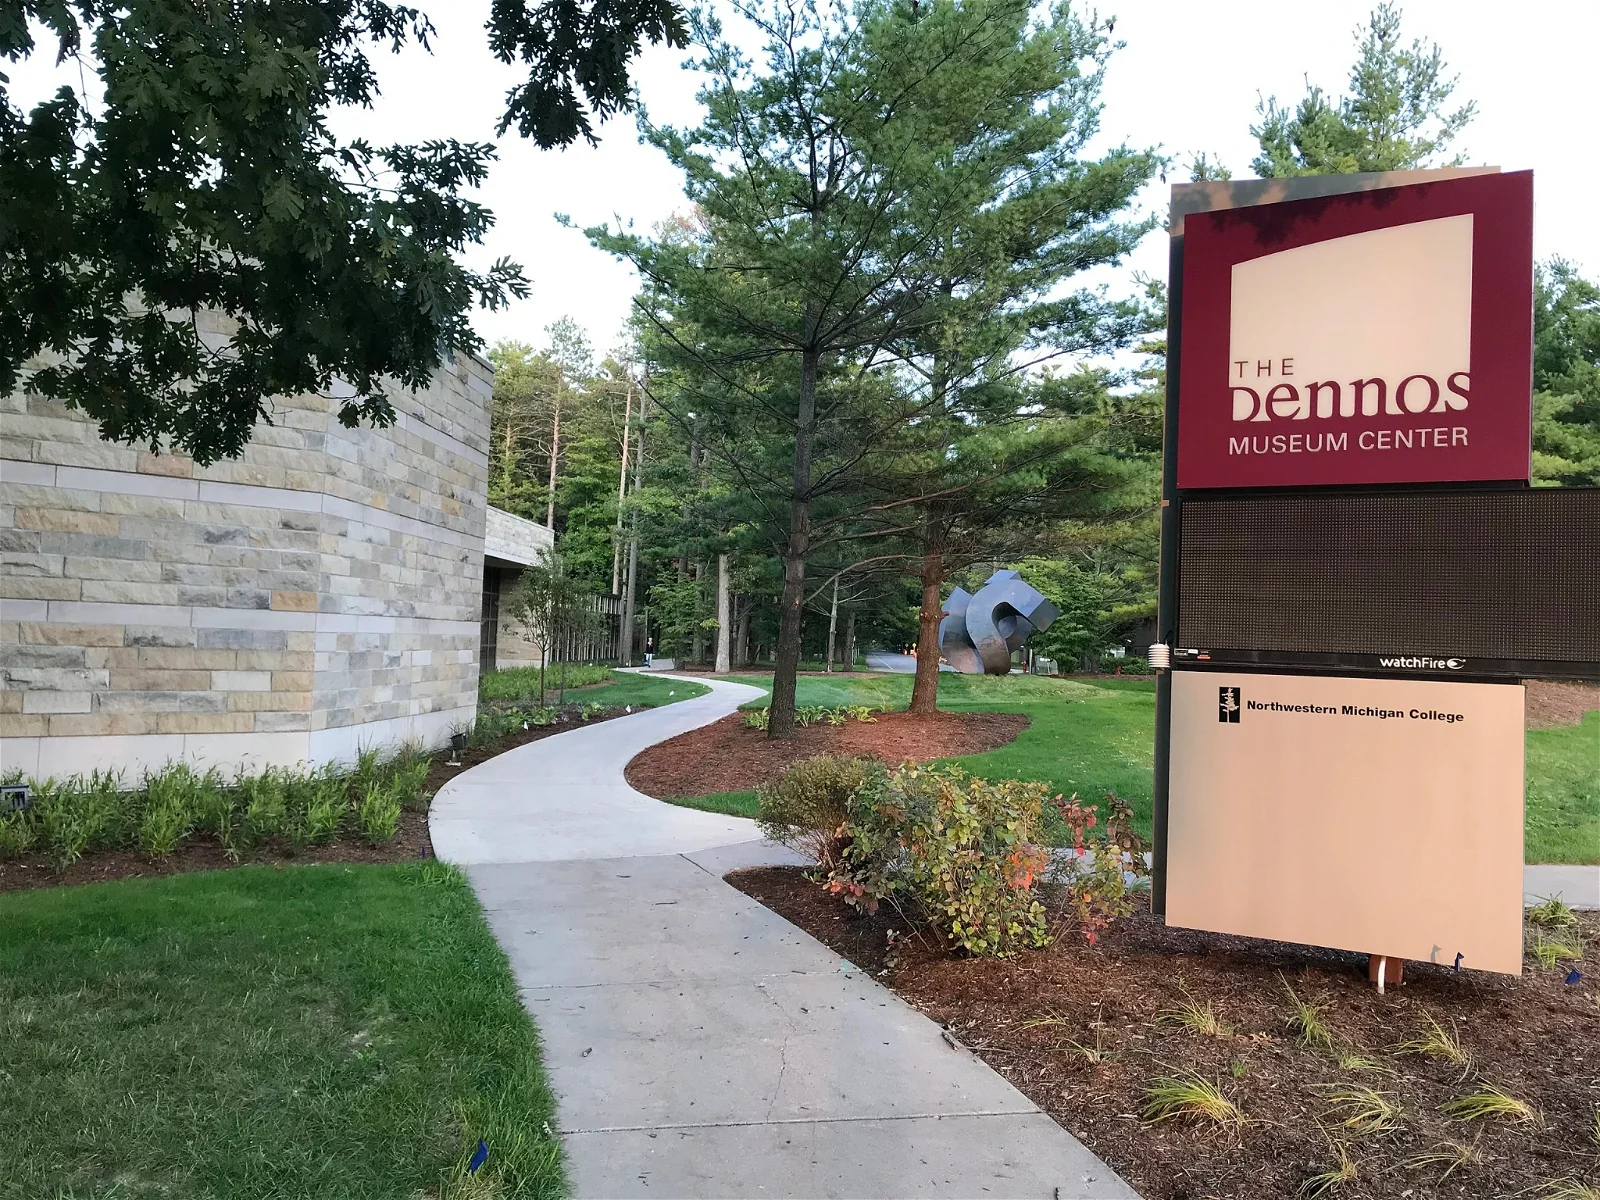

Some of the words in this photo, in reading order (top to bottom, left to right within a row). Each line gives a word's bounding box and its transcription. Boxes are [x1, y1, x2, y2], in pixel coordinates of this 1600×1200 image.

[1234, 358, 1294, 378] THE
[1229, 372, 1471, 422] Dennos
[1229, 432, 1348, 455] MUSEUM
[1358, 426, 1469, 450] CENTER
[1247, 700, 1337, 715] Northwestern
[1341, 705, 1404, 719] Michigan
[1409, 709, 1464, 723] College
